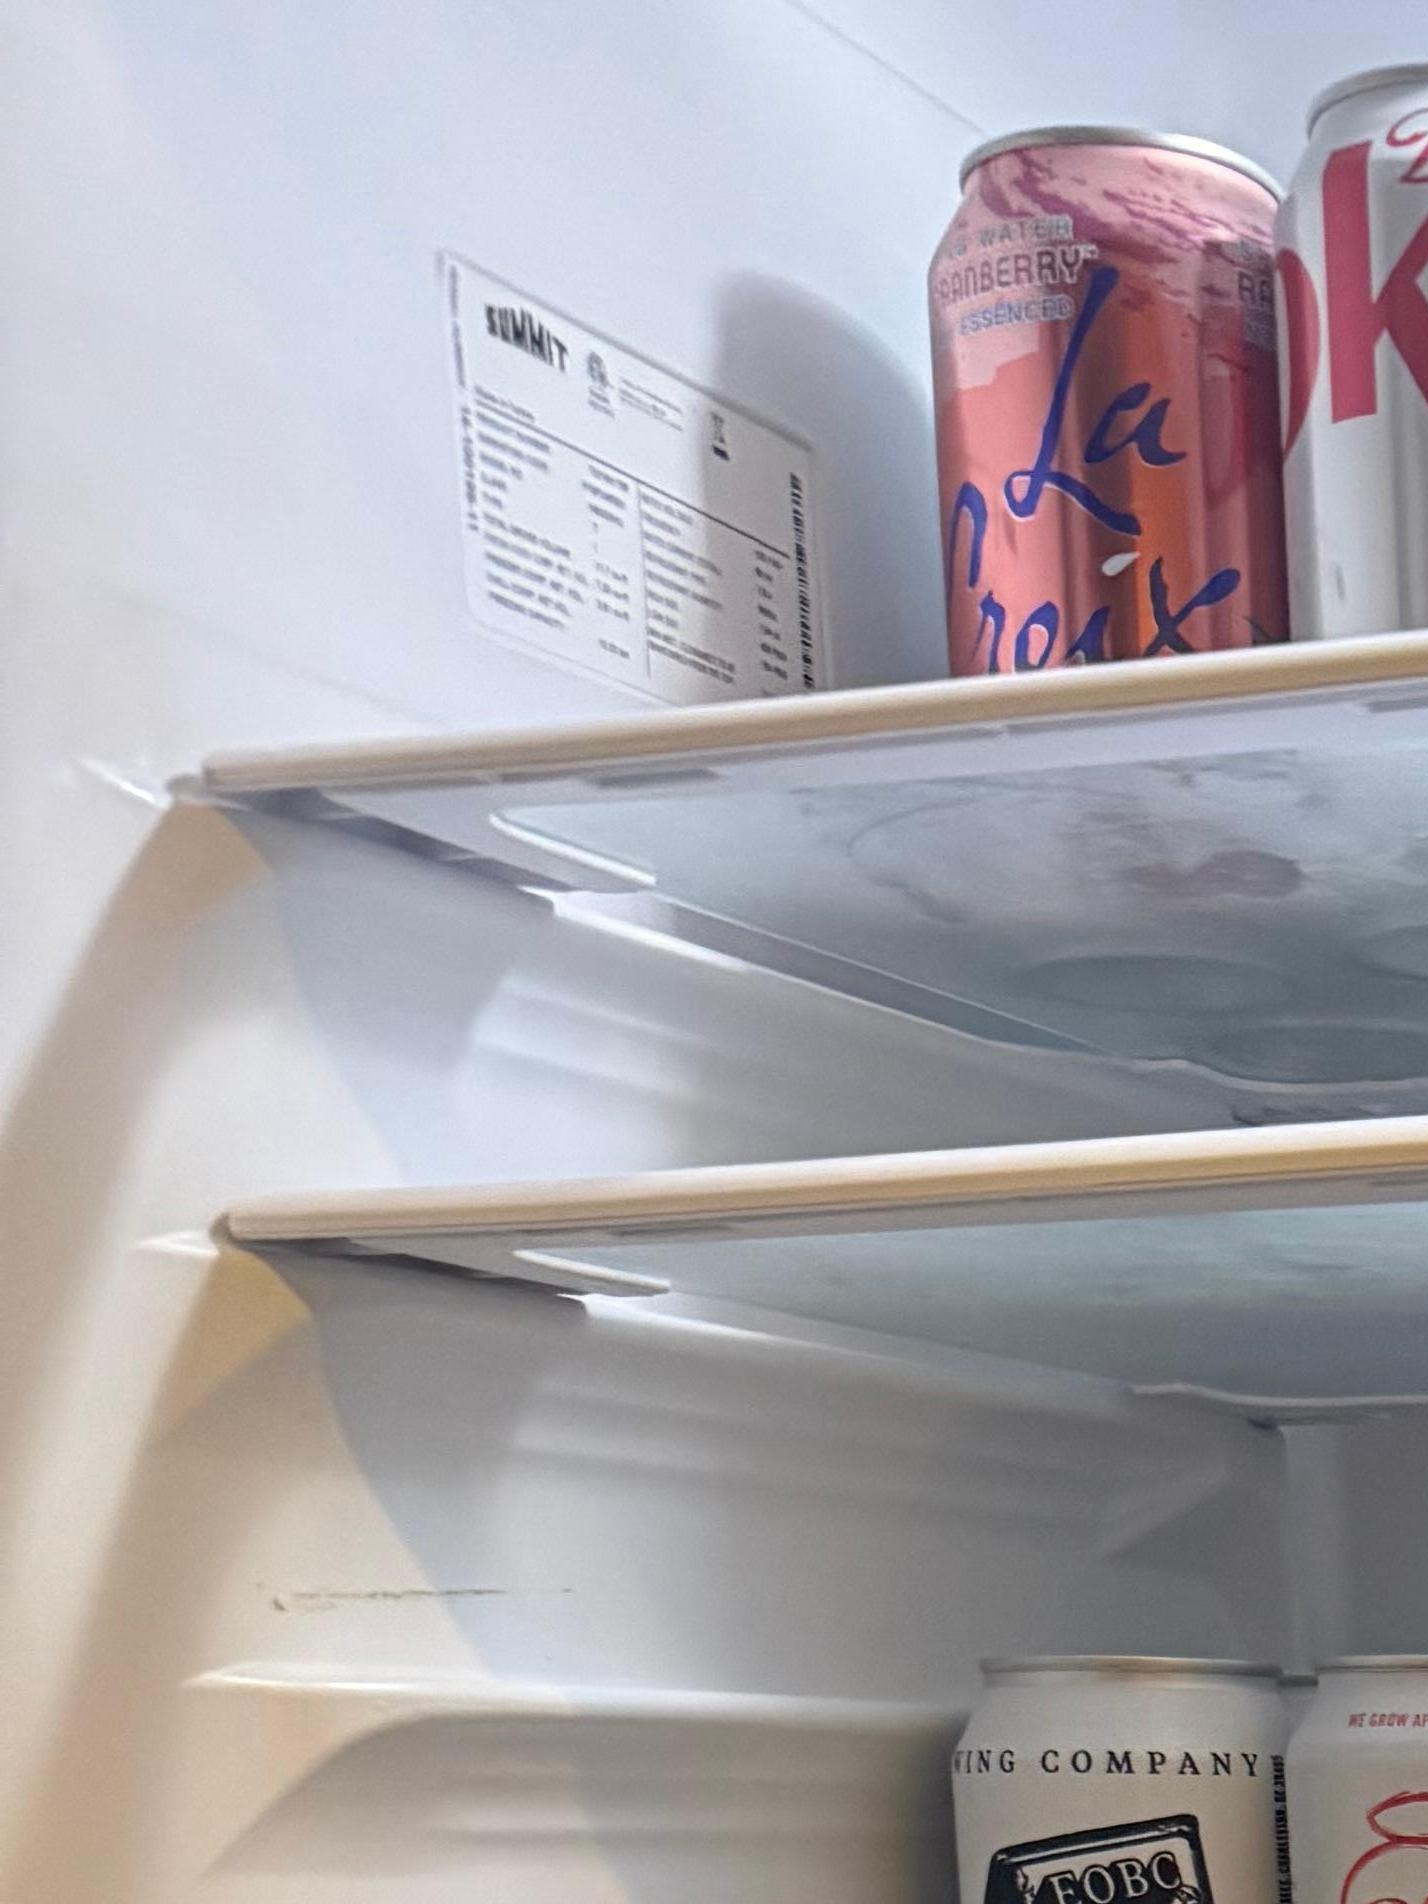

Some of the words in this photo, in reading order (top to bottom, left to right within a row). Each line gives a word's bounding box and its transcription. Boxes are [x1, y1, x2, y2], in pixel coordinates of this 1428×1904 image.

[484, 302, 568, 374] SUMMIT
[1003, 264, 1188, 537] La
[1041, 1749, 1258, 1778] COMPANY
